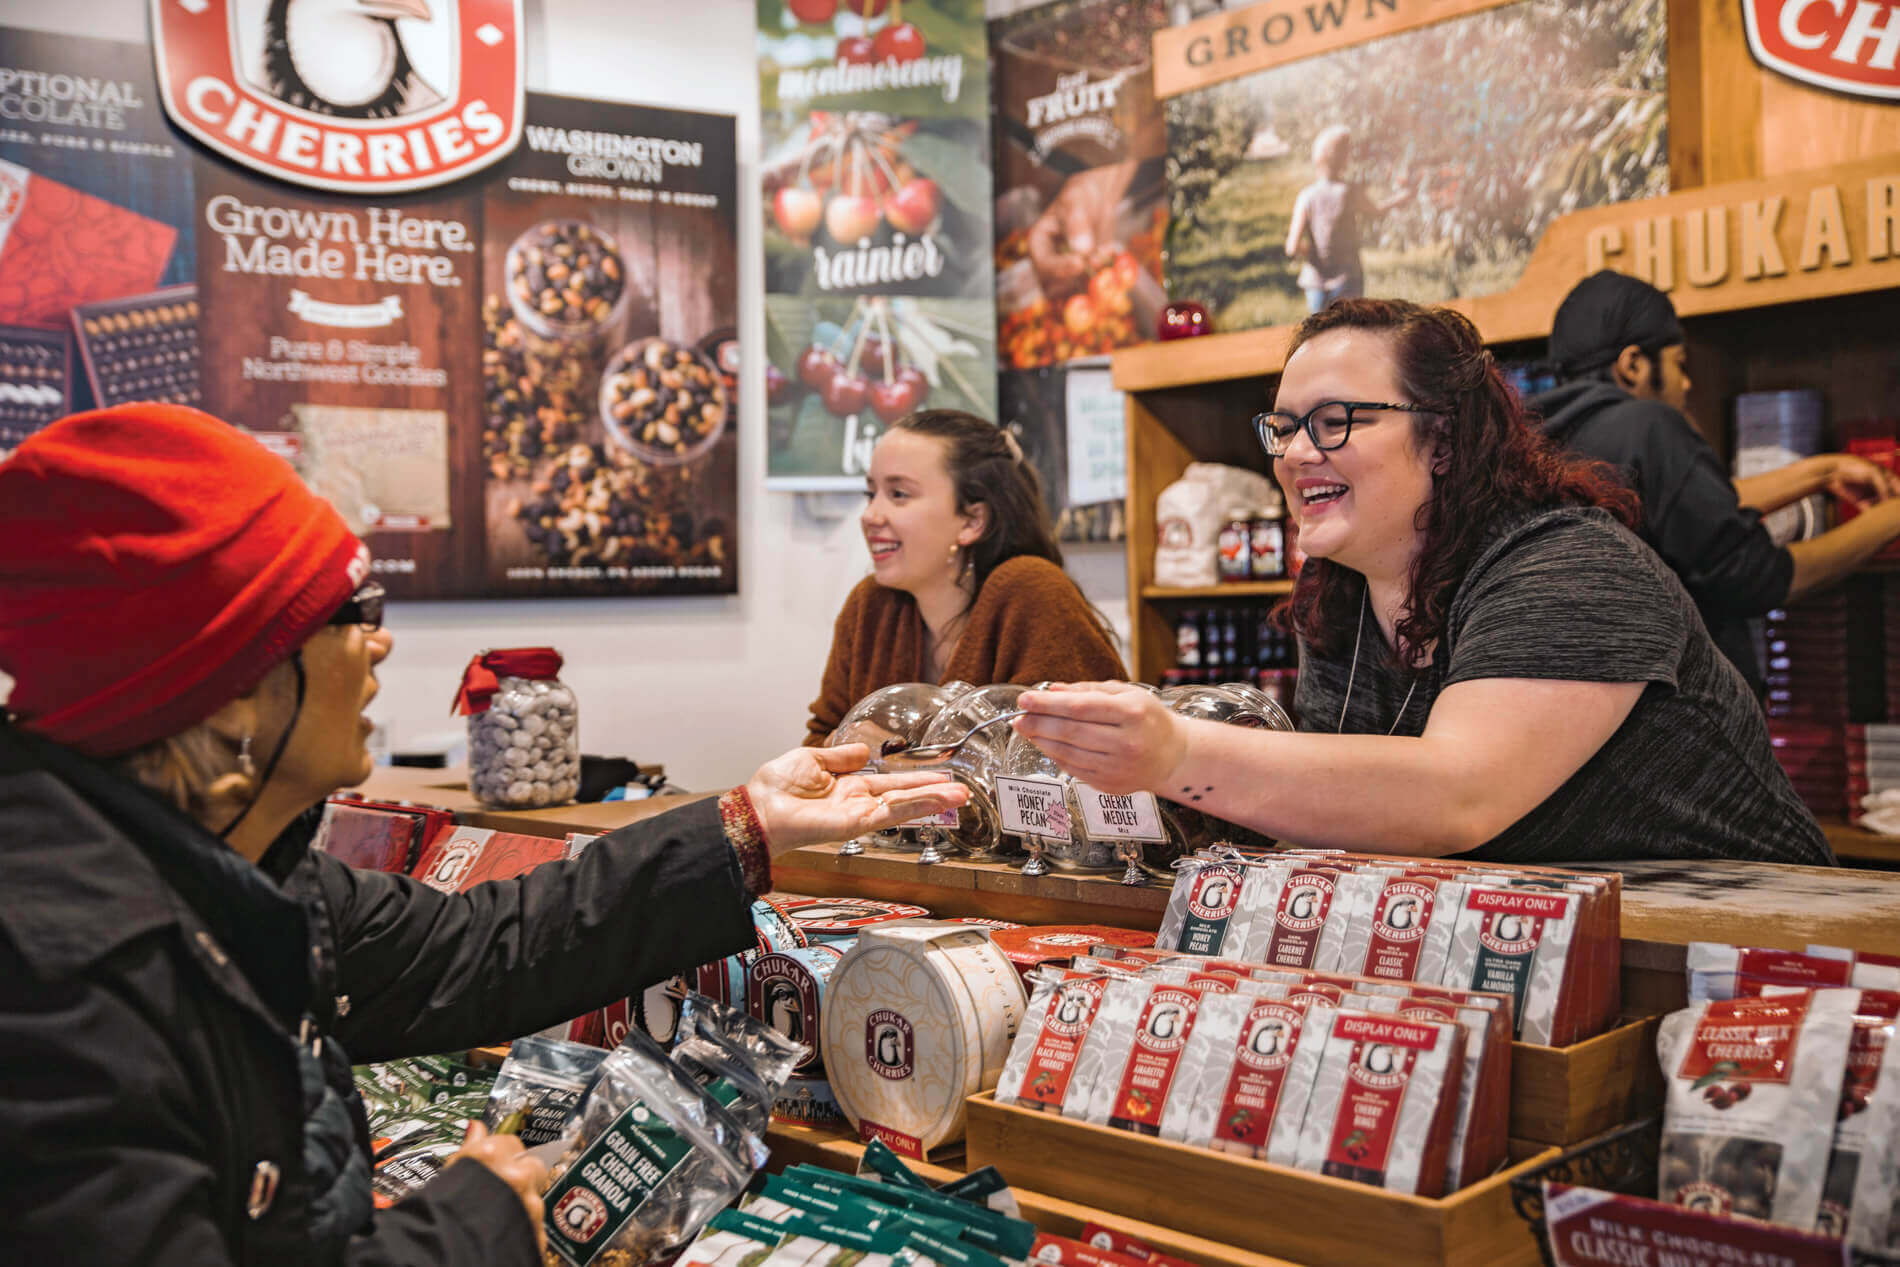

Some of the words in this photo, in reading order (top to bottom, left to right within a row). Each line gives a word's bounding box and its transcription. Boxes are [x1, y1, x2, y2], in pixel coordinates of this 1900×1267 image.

[1026, 74, 1124, 128] FRUIT
[185, 76, 504, 176] CHERRIES
[526, 125, 703, 168] WASHINGTON
[566, 154, 663, 183] GROWN
[206, 195, 358, 243] Grown
[366, 207, 475, 252] Here.
[1586, 176, 1900, 293] CHUKAR
[222, 234, 345, 279] Made
[353, 245, 461, 286] Here.
[814, 231, 945, 290] rainier
[1017, 794, 1045, 812] HONEY
[1098, 793, 1133, 810] CHERRY
[1020, 809, 1047, 828] PECAN
[1102, 810, 1138, 826] MEDLEY
[1287, 875, 1332, 894] CHUKAR
[1384, 885, 1433, 903] CHUKAR
[1190, 901, 1232, 919] CHERRIES
[1477, 893, 1523, 909] DISPLAY
[1525, 898, 1557, 911] ONLY
[1277, 911, 1323, 929] CHERRIES
[1374, 920, 1424, 939] CHERRIES
[1277, 944, 1306, 956] CABERNET
[1481, 932, 1536, 952] CHERRIES
[1276, 954, 1303, 966] CHERRIES
[1379, 956, 1403, 967] CLASSIC
[753, 959, 811, 993] CHUKAR
[1374, 965, 1403, 978] CHERRIES
[1487, 969, 1515, 981] VANILLA
[1149, 992, 1197, 1012] CHUKAR
[869, 1011, 910, 1034] CHUKAR
[1250, 1006, 1302, 1029] CHUKAR
[1137, 1029, 1185, 1049] CHERRIES
[1343, 1020, 1392, 1037] DISPLAY
[1394, 1026, 1428, 1041] ONLY
[1702, 1025, 1755, 1041] CLASSIC
[1237, 1045, 1290, 1066] CHERRIES
[1707, 1042, 1775, 1059] CHERRIES
[869, 1055, 912, 1078] CHERRIES
[1350, 1062, 1409, 1086] CHERRIES
[533, 1106, 567, 1119] GRAIN
[895, 1135, 915, 1152] ONLY
[605, 1130, 641, 1166] GRAIN
[633, 1157, 663, 1185] FREE
[600, 1152, 642, 1192] CHERRY
[581, 1162, 632, 1213] GRANOLA
[1571, 1231, 1650, 1263] CLASSIC
[1590, 1217, 1643, 1240] MILK
[1652, 1230, 1797, 1267] CHOCOLATE
